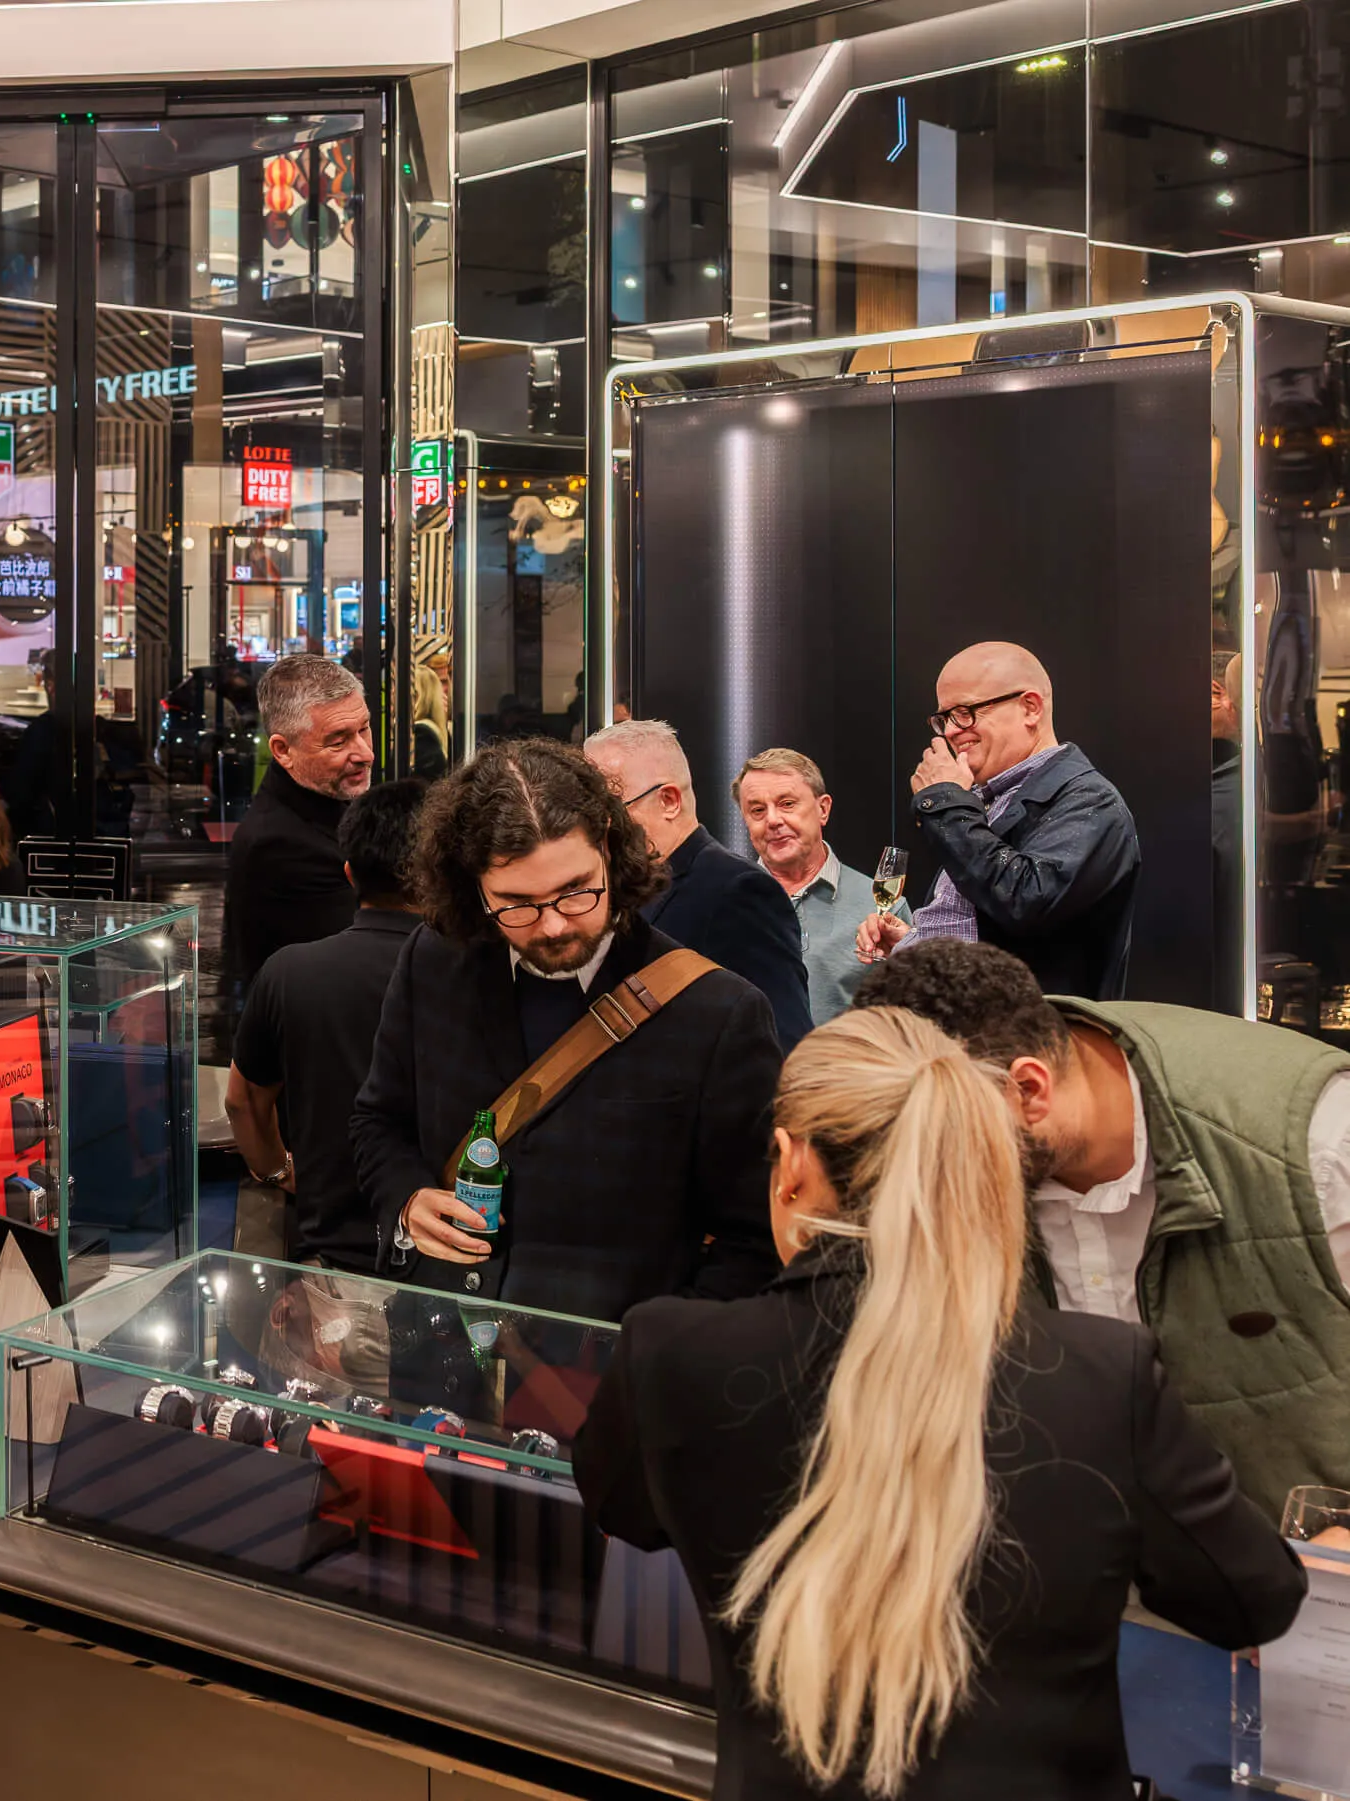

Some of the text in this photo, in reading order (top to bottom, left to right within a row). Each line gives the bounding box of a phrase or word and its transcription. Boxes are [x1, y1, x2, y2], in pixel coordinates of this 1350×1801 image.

[124, 364, 198, 401] FREE
[244, 446, 292, 462] LOTTE
[248, 467, 289, 486] DUTY
[248, 485, 289, 503] FREE
